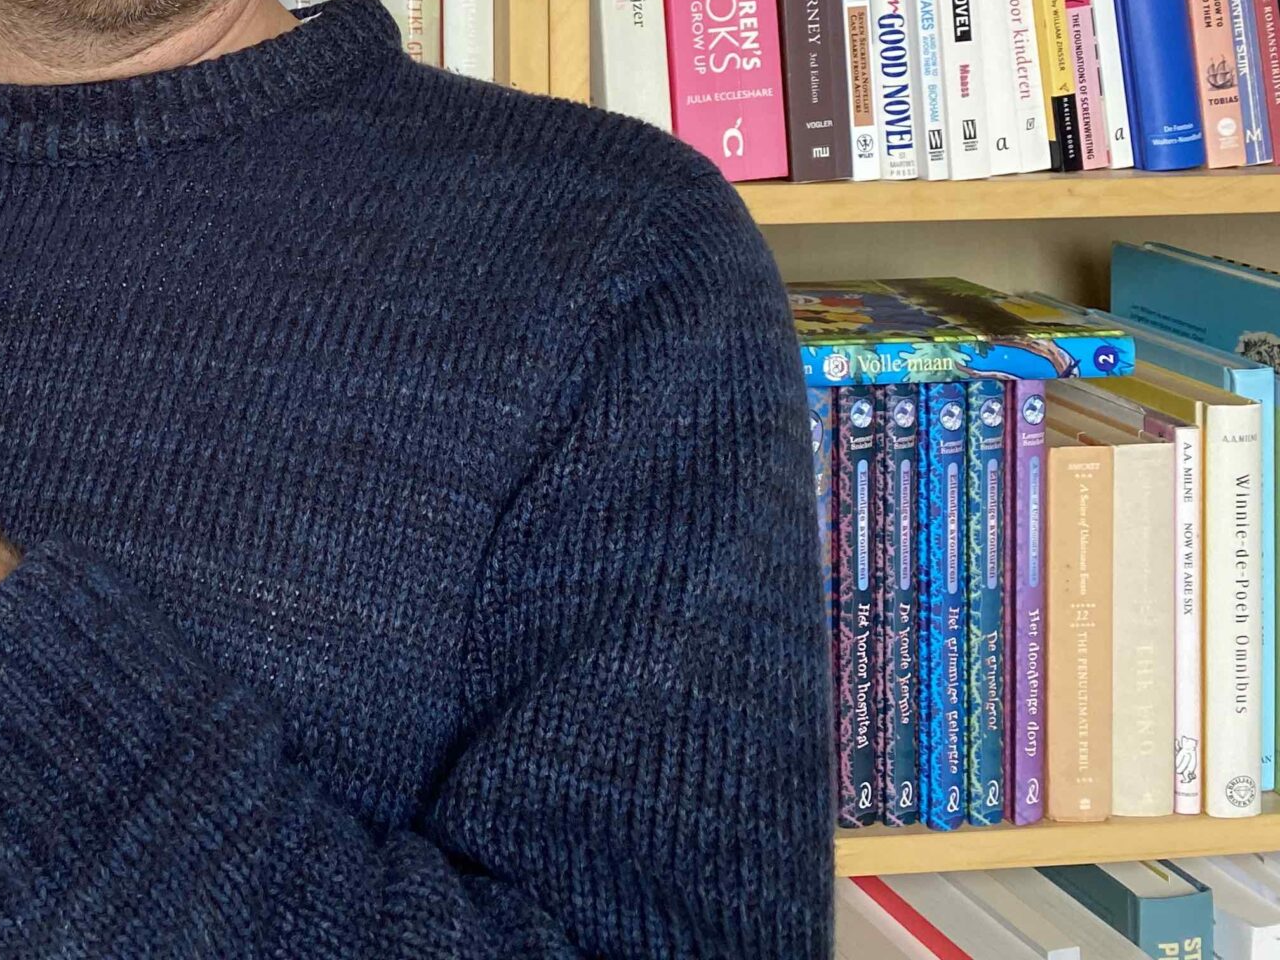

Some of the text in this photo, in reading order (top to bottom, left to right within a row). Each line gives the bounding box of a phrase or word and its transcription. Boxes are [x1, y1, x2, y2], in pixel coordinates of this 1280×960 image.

[878, 13, 908, 79] GOOD
[1012, 27, 1033, 100] kinderen
[687, 88, 773, 105] JULIA ECCLESHARE
[806, 119, 833, 129] VOGLER
[883, 83, 914, 157] NOVEL
[1209, 96, 1239, 106] TOBIAS
[857, 355, 953, 373] Volle maan
[1099, 354, 1114, 364] 2
[1183, 466, 1193, 503] MILNE
[1183, 522, 1193, 616] NOW WE ARE SIX
[1234, 474, 1251, 715] Winnie-de-Poeh Omnibus
[857, 603, 871, 749] Het horror hospitaal
[1025, 608, 1040, 757] Het doodenge dorp
